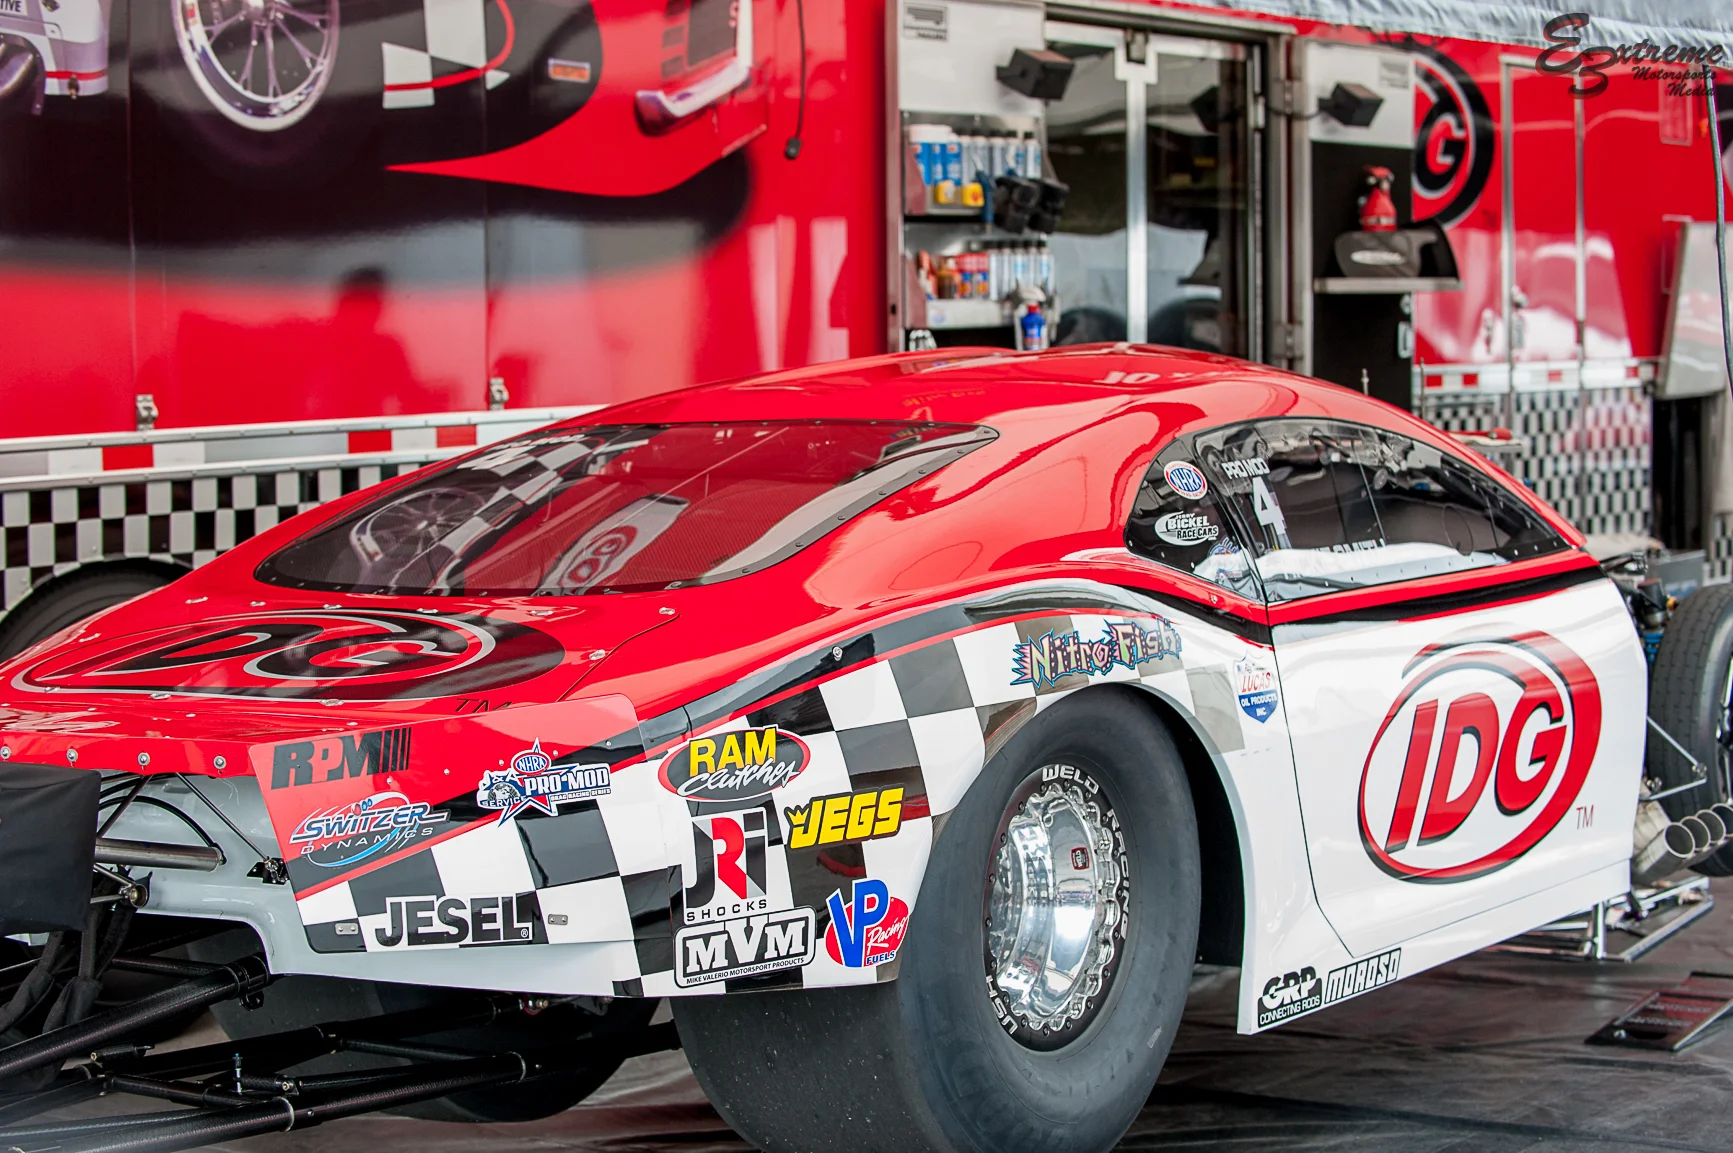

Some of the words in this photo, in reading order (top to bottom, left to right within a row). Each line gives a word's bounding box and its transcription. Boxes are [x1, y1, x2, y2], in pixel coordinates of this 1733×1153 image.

[1169, 467, 1203, 492] NHRA
[1252, 476, 1287, 536] 4
[1167, 515, 1210, 530] BICKEL
[1176, 529, 1198, 539] RACE
[1197, 526, 1218, 537] CARS
[1241, 671, 1271, 693] LUCAS
[271, 731, 382, 790] RPM
[518, 756, 545, 771] NHRA
[688, 726, 778, 777] RAM
[523, 774, 562, 796] PRO
[567, 768, 610, 790] MOD
[1042, 764, 1099, 794] WELD
[291, 804, 447, 842] SWITZER
[788, 787, 904, 849] JEGS
[1576, 805, 1594, 830] TM
[300, 827, 434, 855] DYNAMICS
[686, 899, 768, 922] SHOCKS
[828, 879, 889, 968] VP
[685, 916, 807, 974] MVM
[865, 915, 909, 957] Racing
[686, 975, 702, 985] MIKE
[702, 971, 729, 981] VALERIO
[729, 963, 772, 977] MOTORSPORT
[772, 957, 805, 969] PRODUCTS
[866, 950, 896, 965] FUELS
[1261, 966, 1317, 1010] GRP
[1325, 948, 1401, 1004] MOROSO
[1259, 1004, 1301, 1025] CONNECTING
[1301, 994, 1321, 1010] RODS
